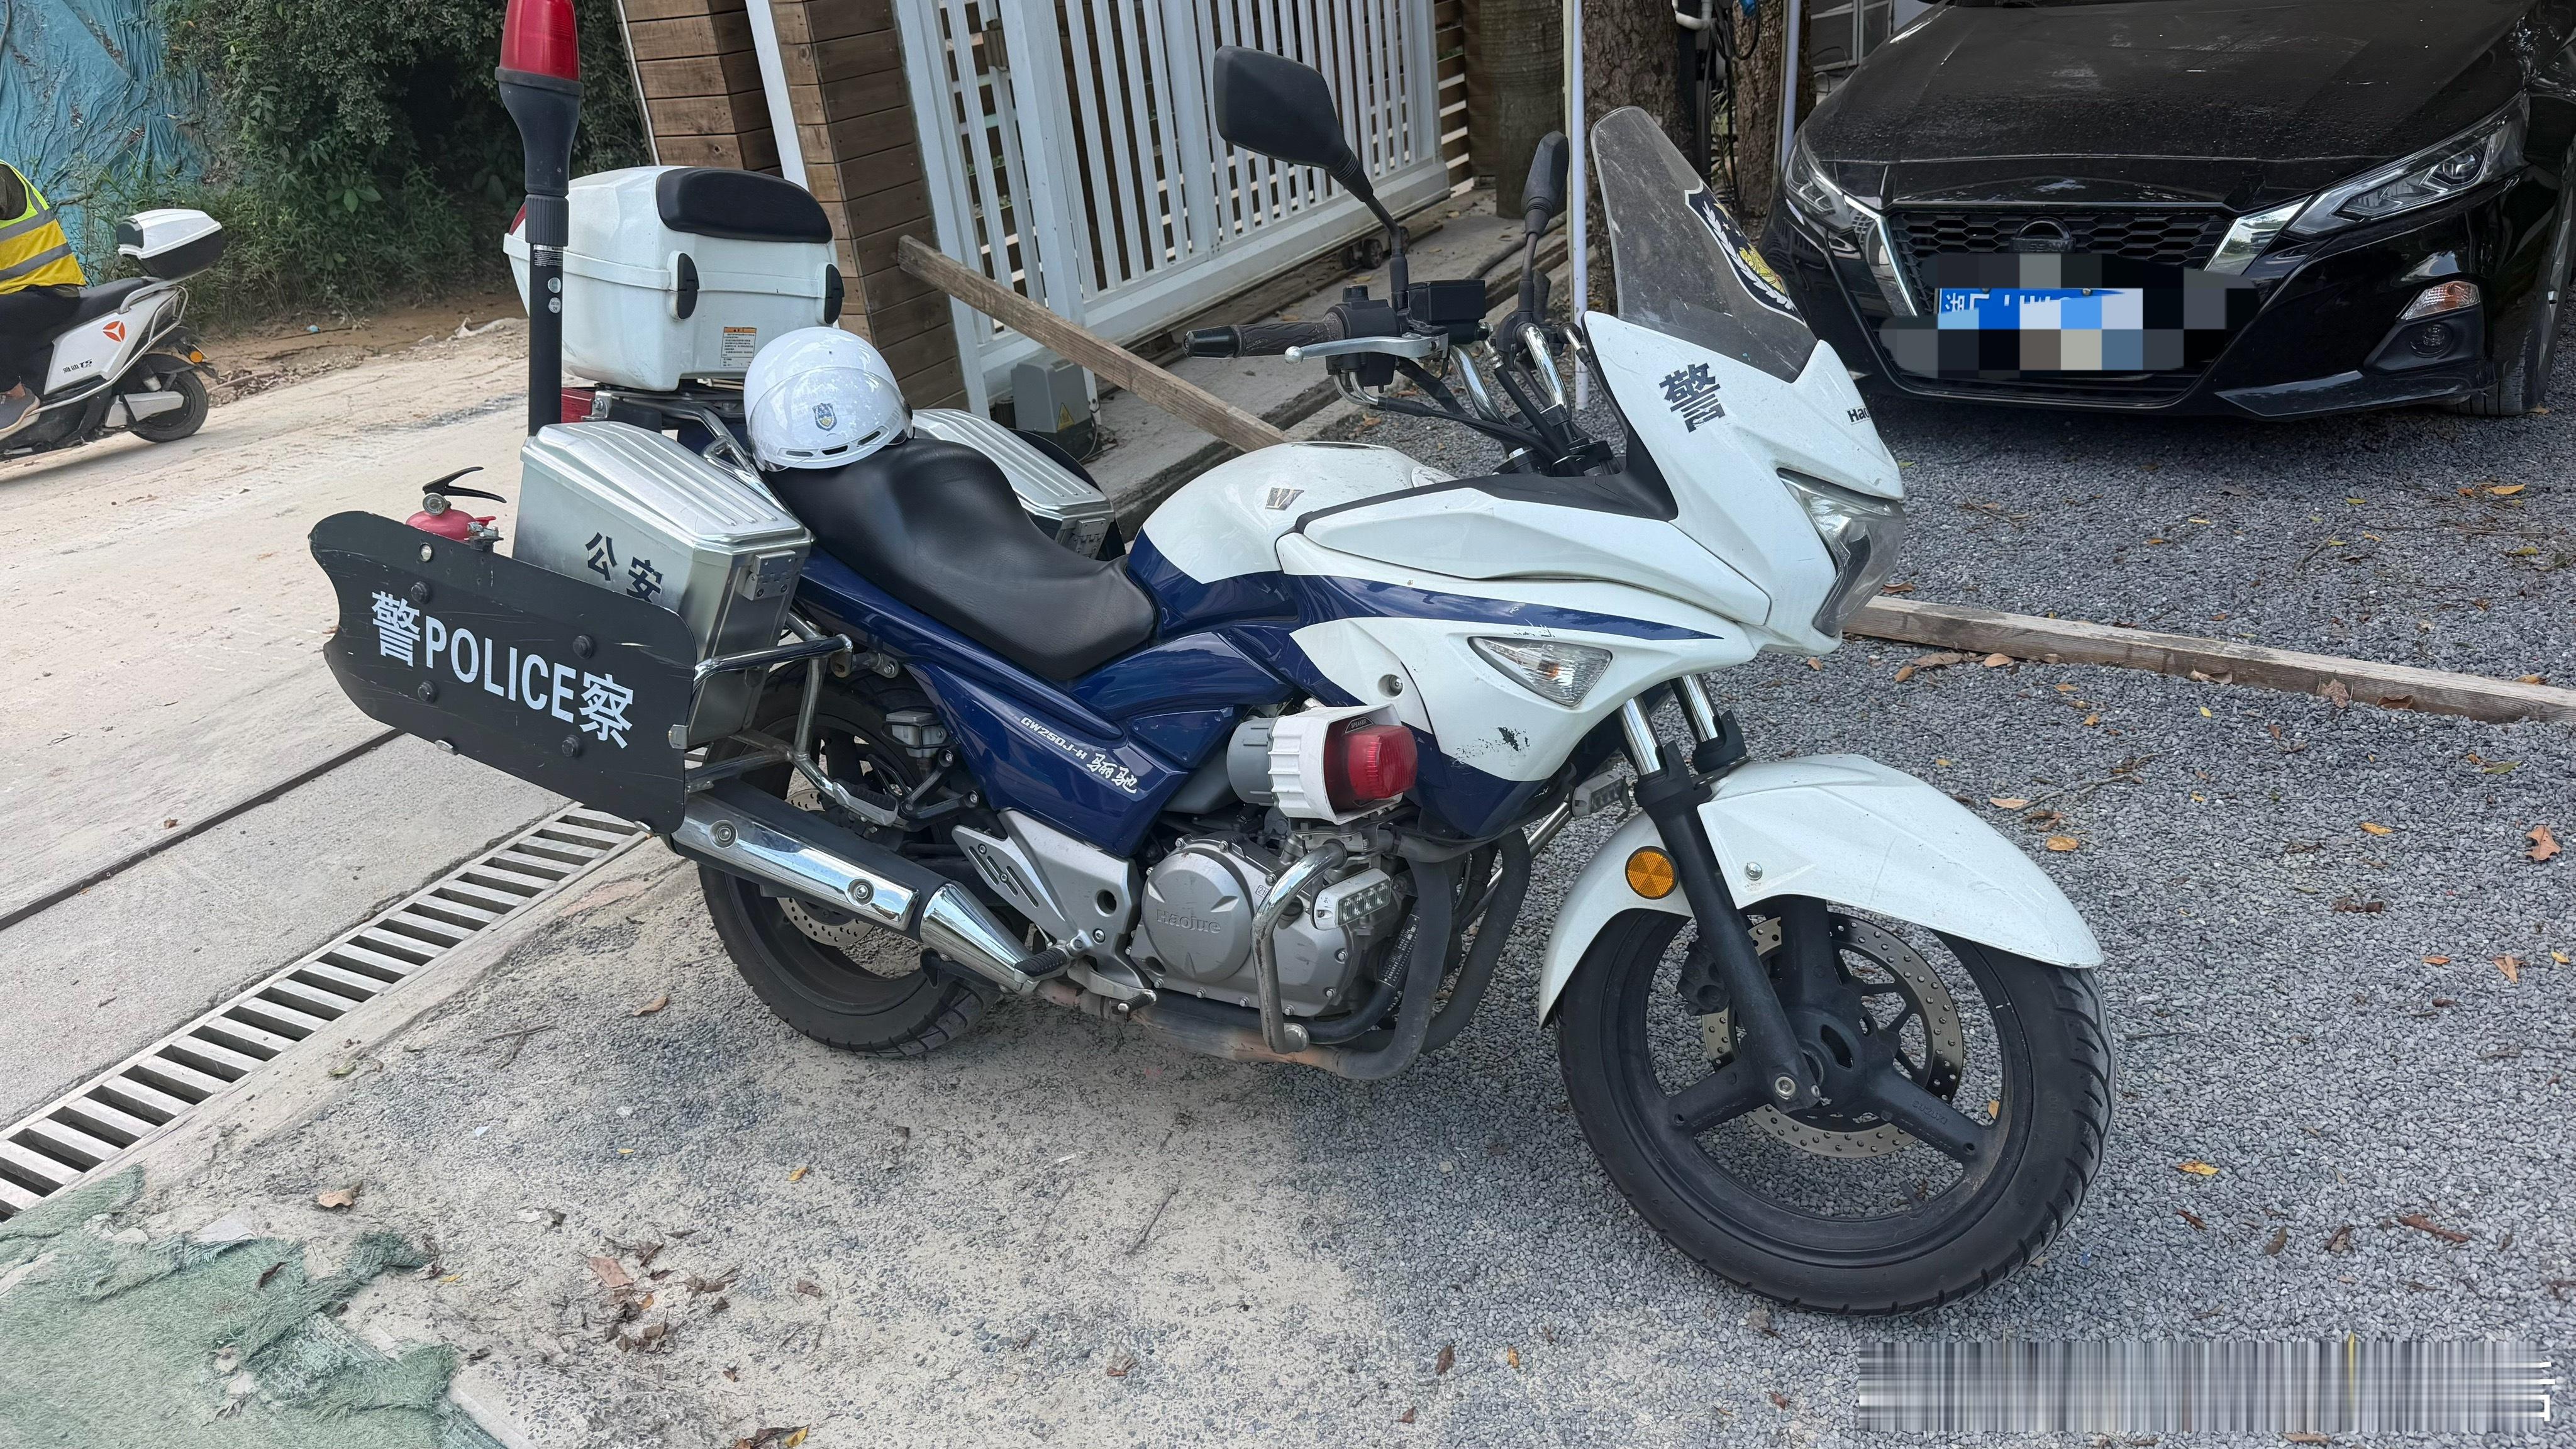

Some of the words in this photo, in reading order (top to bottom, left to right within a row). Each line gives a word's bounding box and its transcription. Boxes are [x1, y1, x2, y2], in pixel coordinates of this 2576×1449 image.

[1658, 363, 1725, 433] 警
[585, 532, 663, 603] 公安
[1020, 717, 1088, 760] GW250J-H
[1087, 753, 1138, 794] 骊驰
[1157, 909, 1221, 934] Haojue
